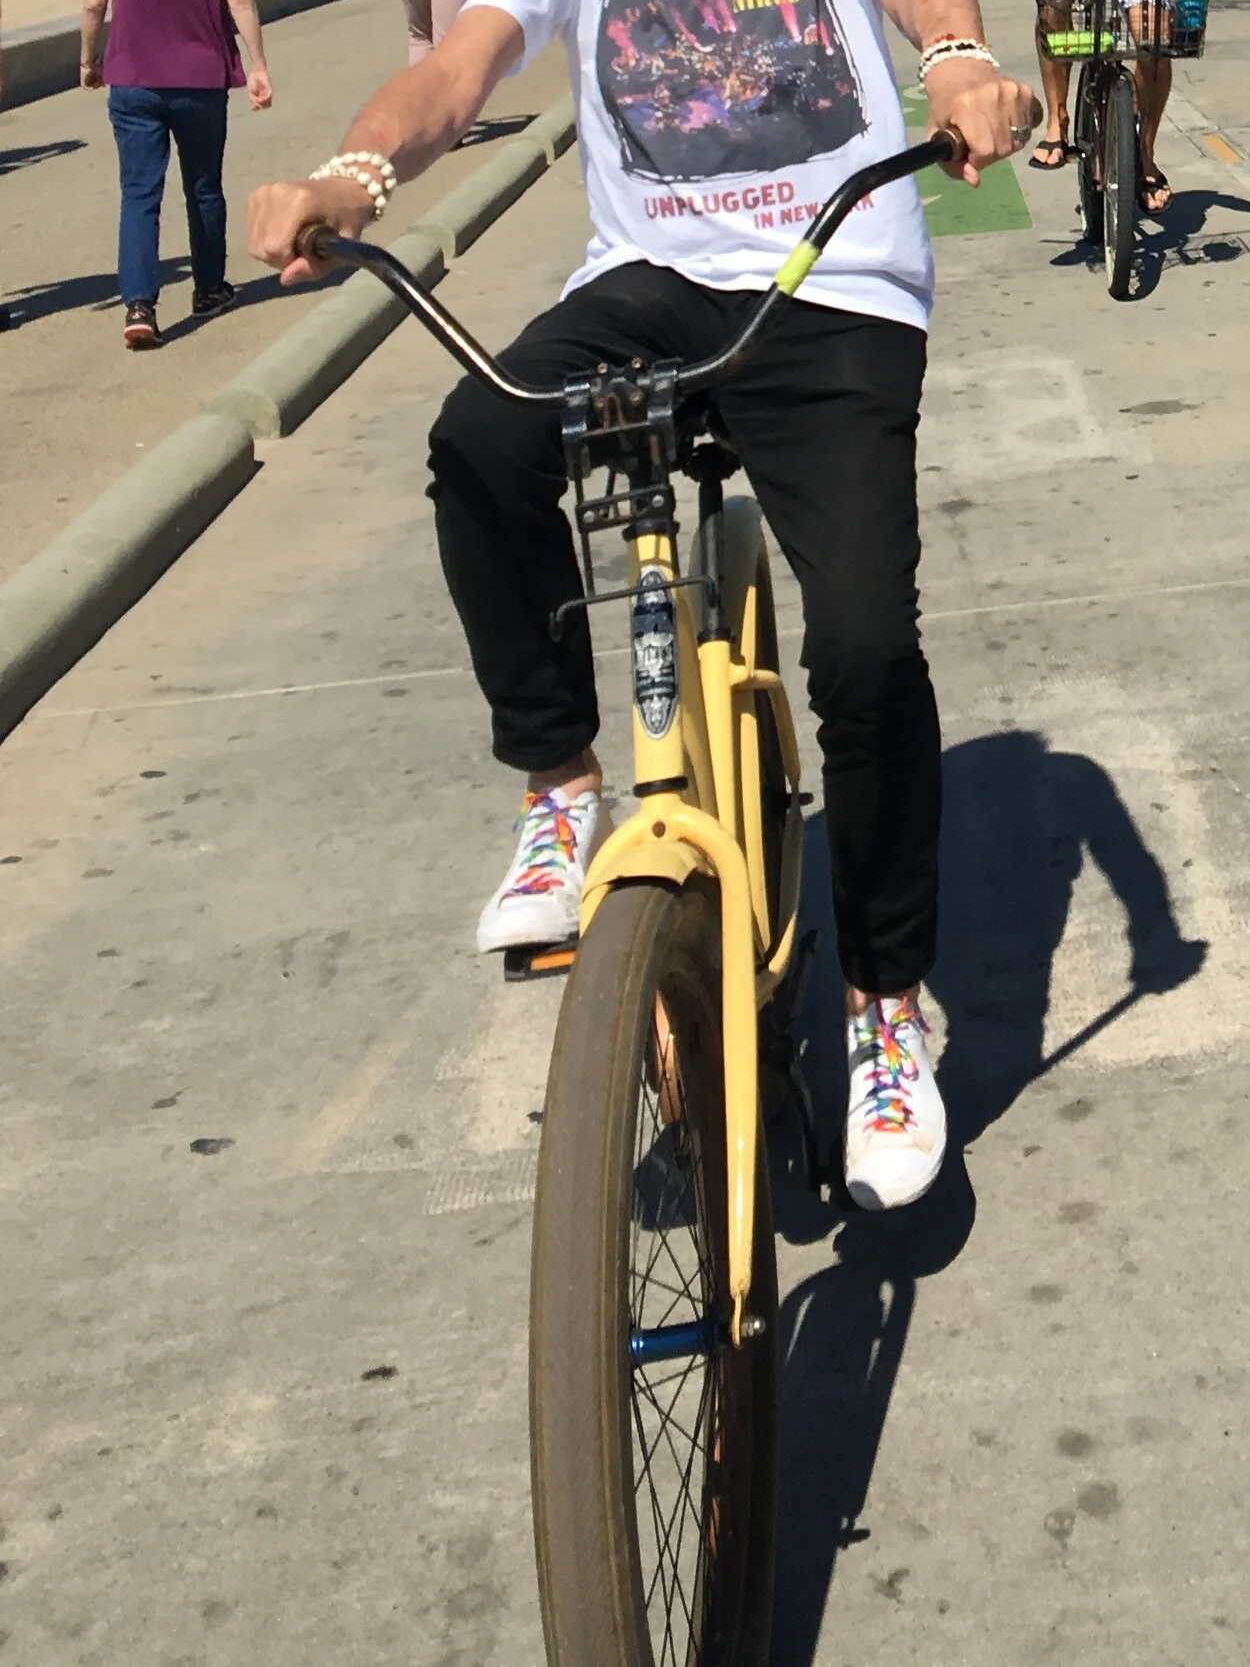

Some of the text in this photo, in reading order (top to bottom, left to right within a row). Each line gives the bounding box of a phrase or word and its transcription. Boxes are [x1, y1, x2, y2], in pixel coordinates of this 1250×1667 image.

[644, 181, 795, 220] UNPLUGGED
[753, 201, 819, 231] IN NEW
